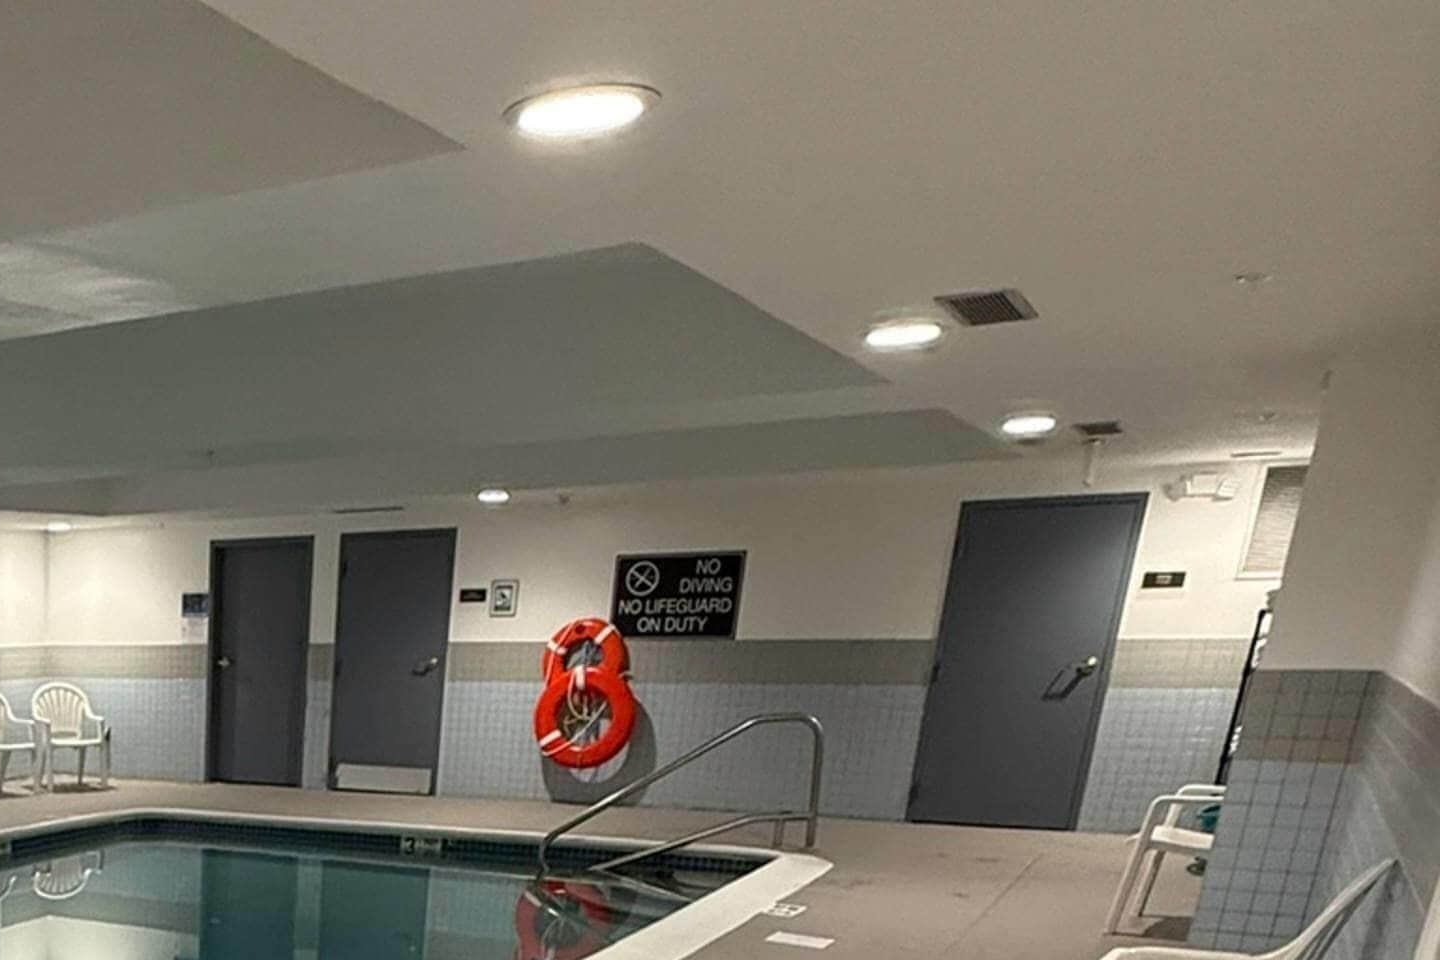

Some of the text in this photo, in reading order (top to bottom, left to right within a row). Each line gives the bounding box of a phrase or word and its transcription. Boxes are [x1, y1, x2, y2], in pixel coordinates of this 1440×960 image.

[696, 558, 721, 574] NO
[679, 577, 733, 593] DIVING
[619, 597, 732, 615] NO LIFEGUARD
[636, 616, 709, 633] ON DUTY
